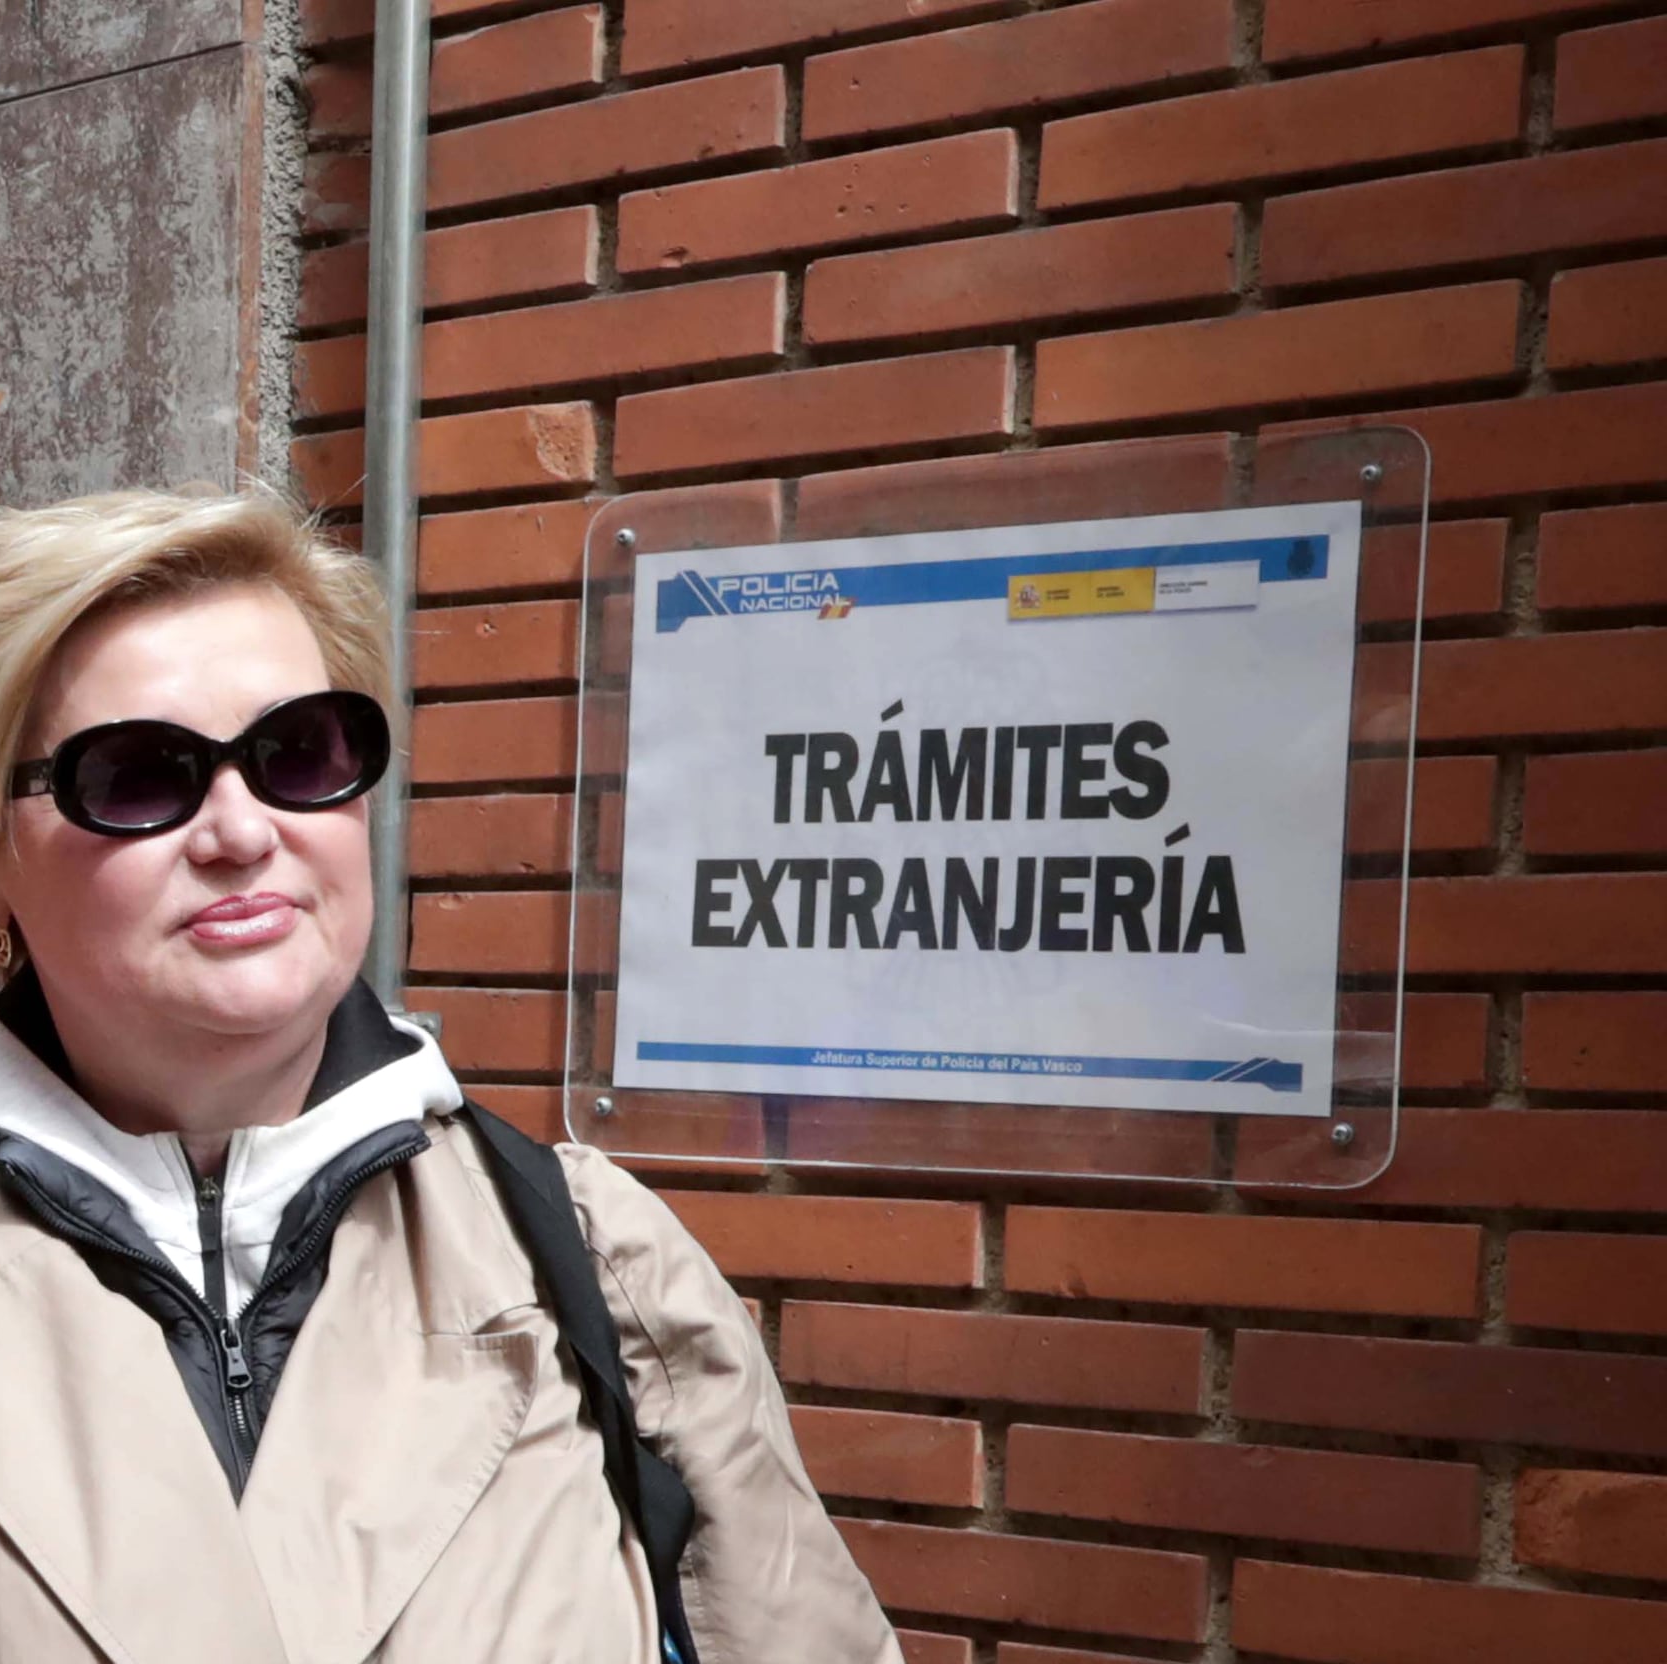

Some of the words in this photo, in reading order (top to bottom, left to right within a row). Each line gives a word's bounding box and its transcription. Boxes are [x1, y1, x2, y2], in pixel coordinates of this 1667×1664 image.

[739, 593, 852, 613] NACIONAL
[765, 698, 1171, 824] TRÁMITES
[691, 822, 1247, 955] EXTRANJERÍA
[811, 1050, 863, 1066] Jefatura
[865, 1051, 919, 1069] Superior
[921, 1053, 938, 1069] de
[987, 1056, 1009, 1071] del
[1041, 1058, 1084, 1074] Vasco
